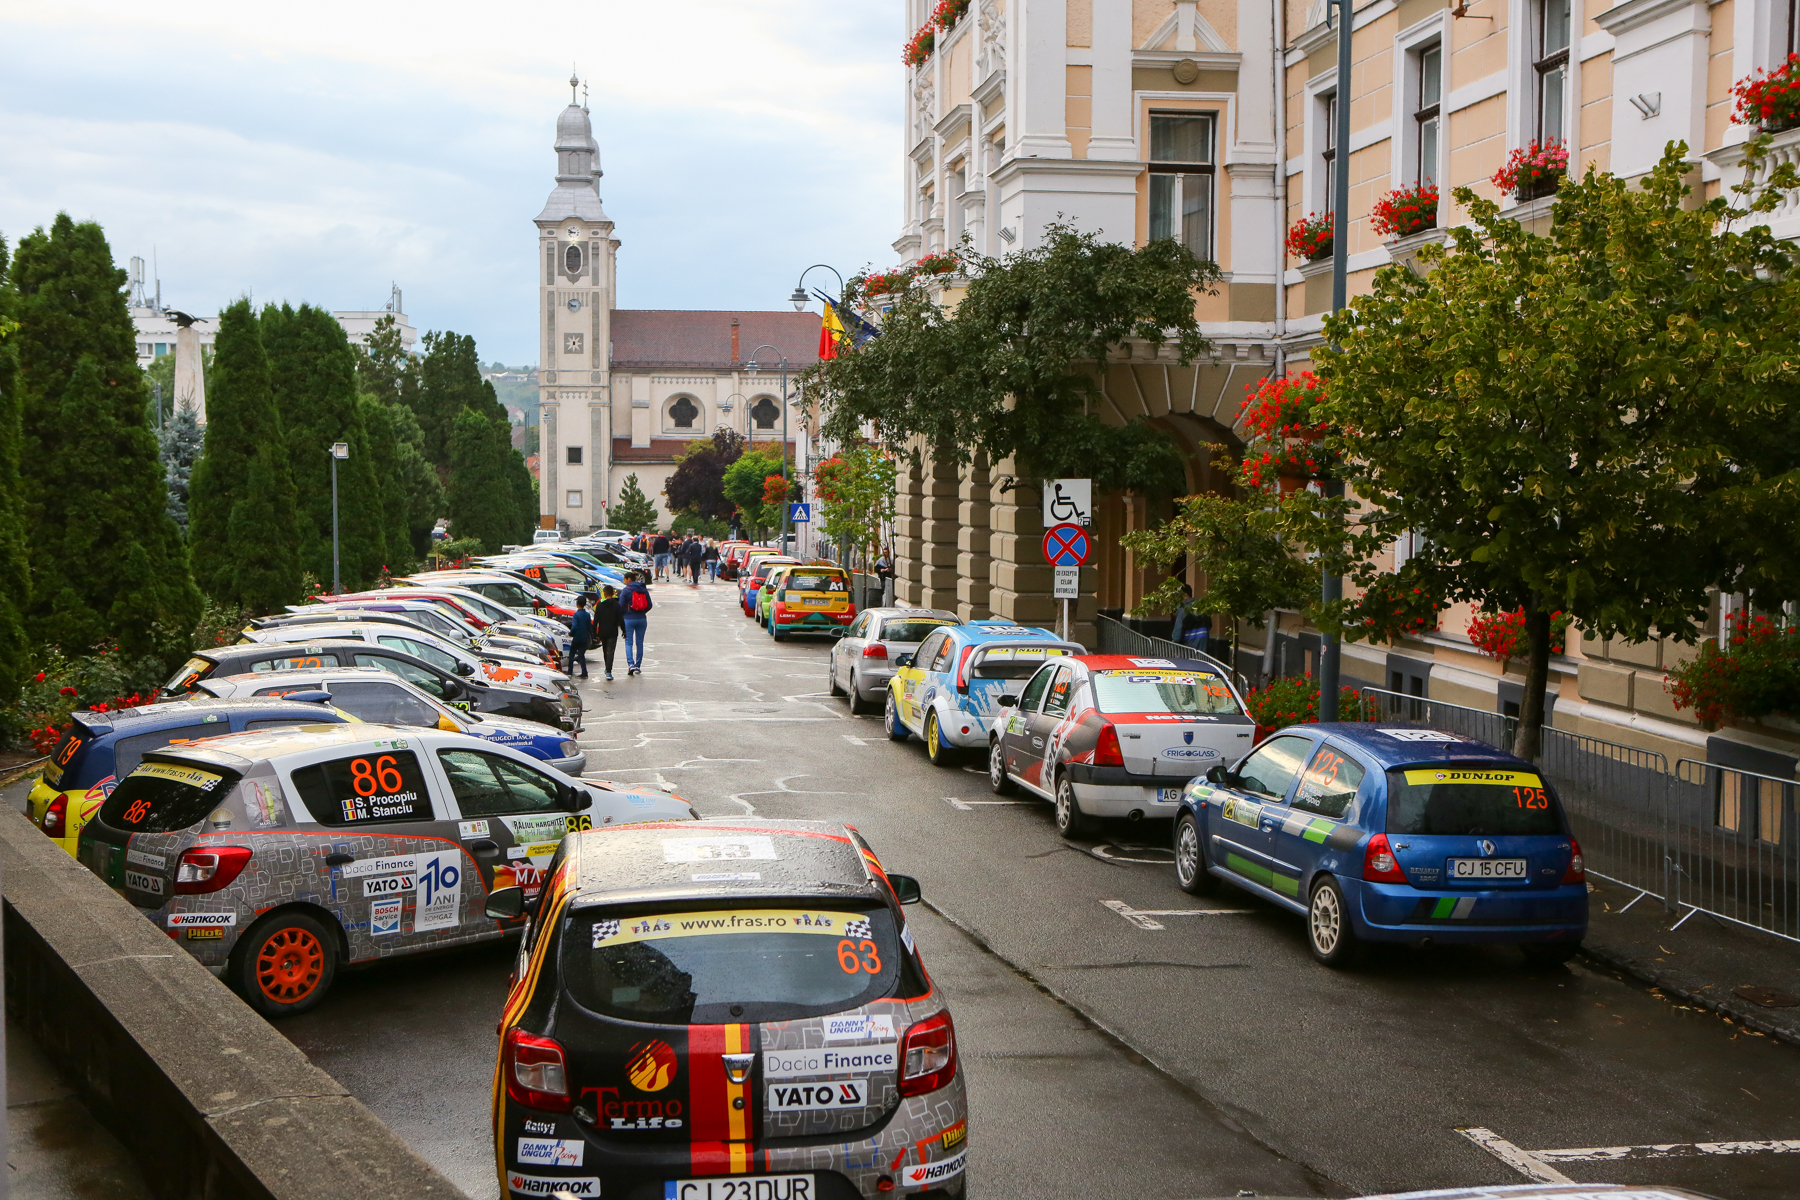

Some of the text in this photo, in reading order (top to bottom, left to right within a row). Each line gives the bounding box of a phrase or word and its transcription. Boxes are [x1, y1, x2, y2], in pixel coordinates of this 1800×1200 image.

[524, 568, 540, 578] 413
[829, 582, 843, 591] A1
[182, 673, 199, 687] 72
[1202, 685, 1232, 698] 123
[57, 735, 82, 766] 79
[151, 767, 186, 778] www.fras.ro
[1308, 749, 1345, 786] 125
[350, 755, 403, 797] 86
[1450, 772, 1514, 782] DUNLOP
[355, 790, 417, 808] S. Procopiu
[1163, 789, 1177, 800] AG
[1513, 786, 1548, 809] 125
[123, 799, 151, 824] 86
[357, 804, 413, 819] M. Stanciu
[513, 817, 565, 830] RALIUL HARGHITEI
[565, 814, 592, 834] 86
[128, 850, 165, 867] Dacia Finance
[345, 860, 414, 875] Dacia Finance
[1457, 861, 1524, 875] CJ 15 CFU
[127, 873, 149, 889] YATO
[366, 879, 398, 894] YATO
[433, 894, 455, 906] ANI
[374, 905, 399, 915] BOSCH
[373, 914, 398, 922] Service
[424, 912, 453, 923] ROMGAZ
[634, 915, 832, 933] FRAS www.fras.ro FRAS
[188, 928, 222, 938] Pilot
[838, 939, 882, 975] 63
[830, 1026, 864, 1034] UNGUR
[831, 1020, 865, 1028] DANNY
[768, 1053, 893, 1073] Dacia Finance
[774, 1086, 834, 1107] YATO
[580, 1086, 682, 1129] Termo
[610, 1117, 683, 1129] Life
[942, 1124, 966, 1148] Pilot
[521, 1150, 553, 1158] UNGUR
[523, 1143, 555, 1151] DANNY
[722, 1180, 752, 1200] 23
[755, 1178, 810, 1200] DUR
